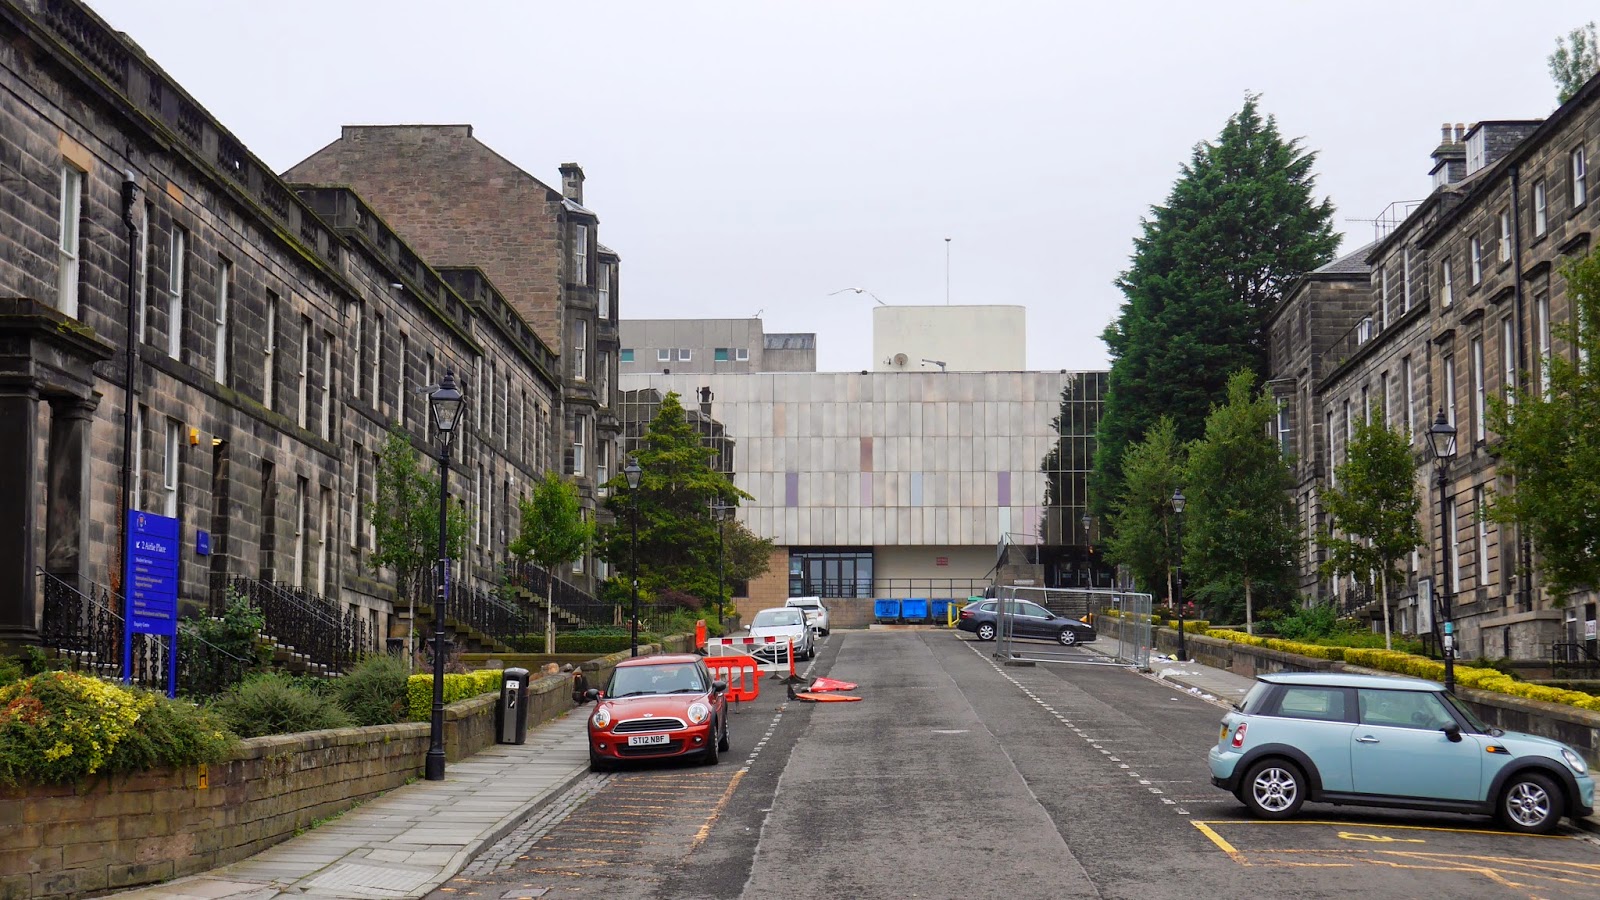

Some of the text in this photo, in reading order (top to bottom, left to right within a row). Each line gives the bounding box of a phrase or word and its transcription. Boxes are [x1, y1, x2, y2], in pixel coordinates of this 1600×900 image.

[141, 540, 167, 553] 2 Airlie Place
[632, 735, 665, 744] ST12 NBF
